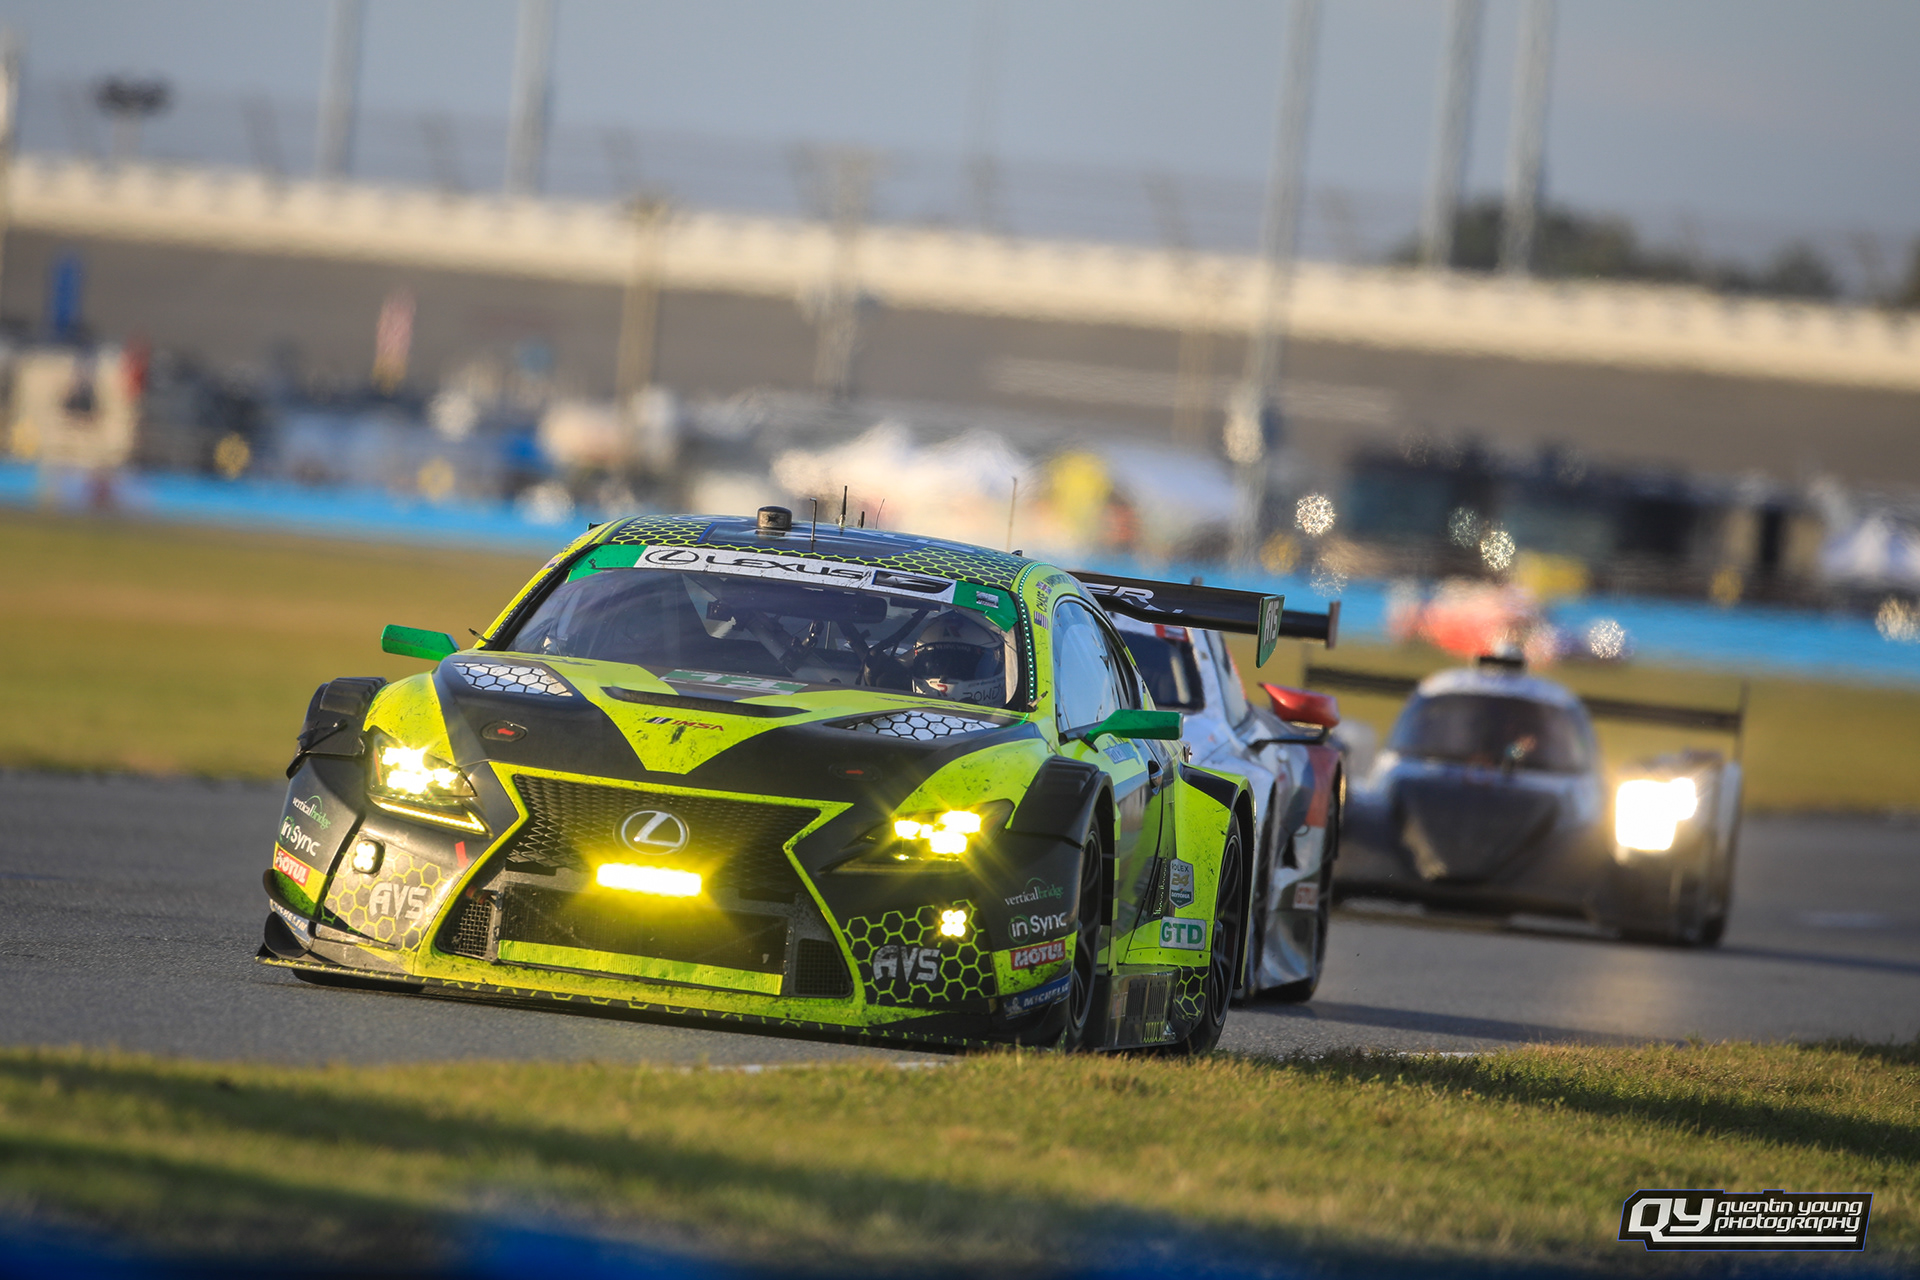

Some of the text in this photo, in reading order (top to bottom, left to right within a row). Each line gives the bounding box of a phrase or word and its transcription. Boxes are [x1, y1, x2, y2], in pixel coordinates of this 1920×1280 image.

[706, 553, 864, 580] LEXUS
[671, 719, 725, 732] IMSA
[276, 850, 307, 884] MOTUL
[1171, 872, 1190, 887] 24
[369, 881, 428, 920] AVS
[1161, 921, 1203, 945] GTD
[873, 944, 941, 983] AVS
[1014, 942, 1064, 967] MOTUL
